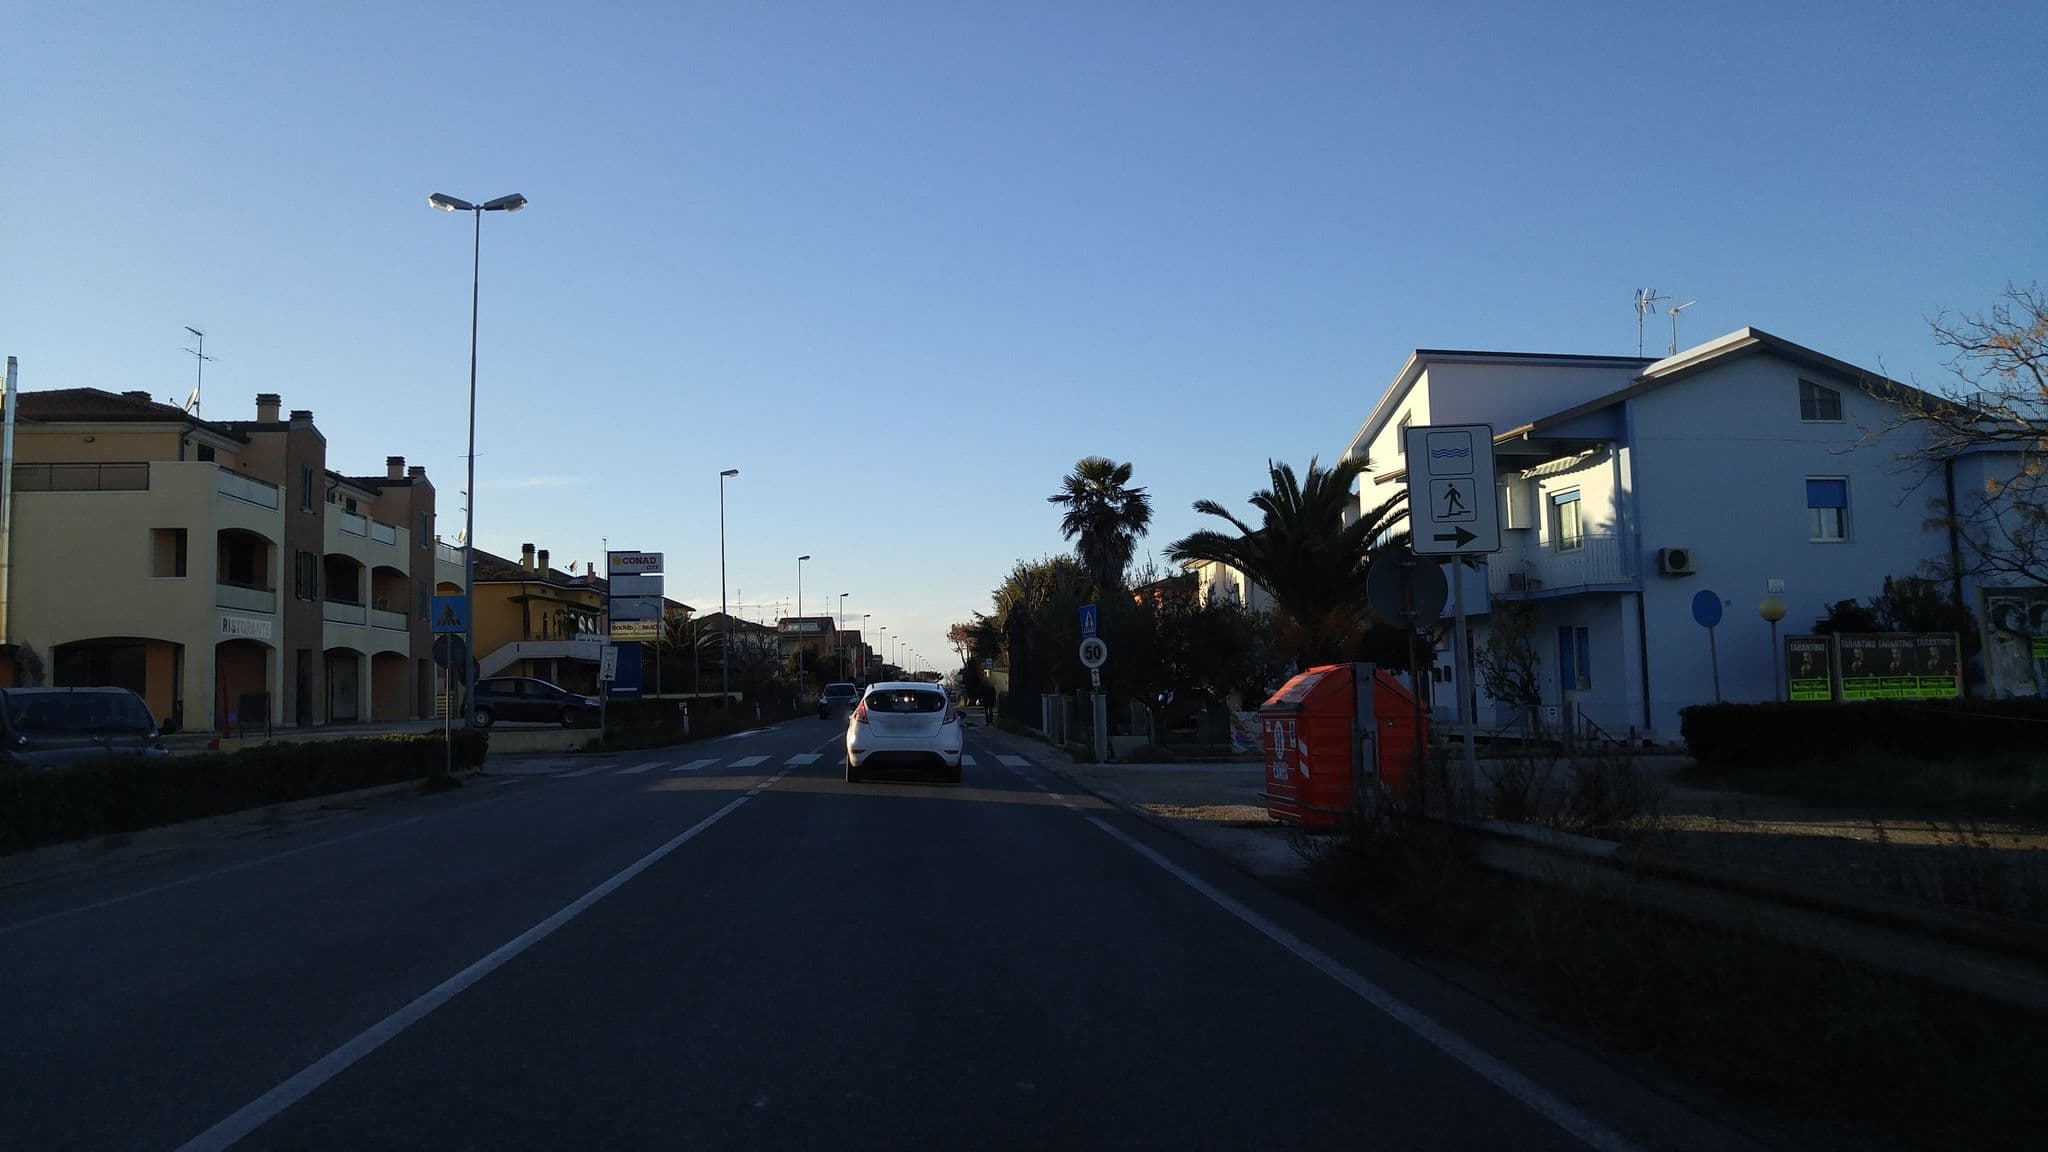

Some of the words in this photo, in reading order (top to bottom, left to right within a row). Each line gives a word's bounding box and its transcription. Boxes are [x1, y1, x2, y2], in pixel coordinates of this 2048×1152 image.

[622, 556, 657, 565] CONAD
[222, 616, 271, 638] RISTORANTE
[1841, 640, 1876, 648] TARANTINO
[1085, 645, 1101, 660] 50
